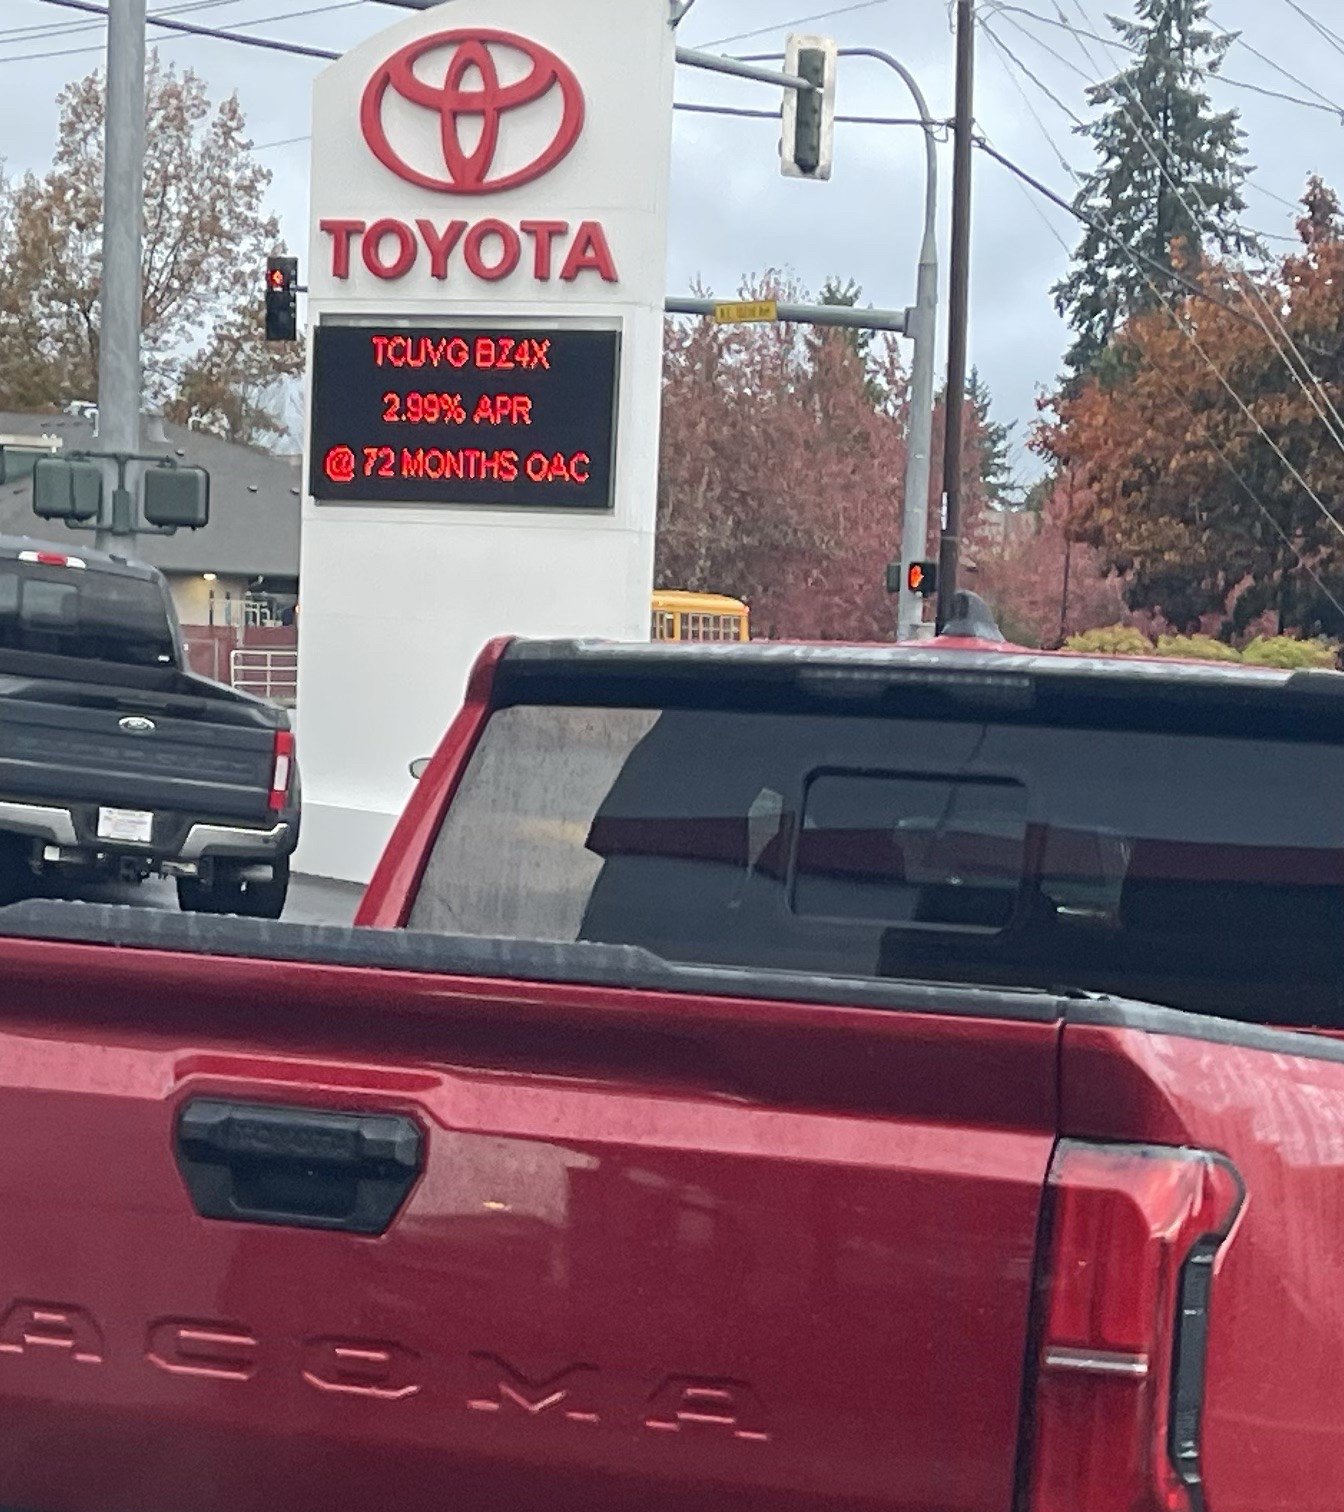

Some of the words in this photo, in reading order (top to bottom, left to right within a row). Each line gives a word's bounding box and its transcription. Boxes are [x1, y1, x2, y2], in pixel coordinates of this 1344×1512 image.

[319, 218, 619, 283] TOYOTA
[474, 337, 551, 370] BZ4X
[381, 391, 467, 425] 2.99%
[472, 393, 533, 425] APR
[323, 446, 355, 482] @
[363, 446, 395, 477] 72
[401, 447, 520, 482] MONTHS
[524, 450, 591, 483] OAC
